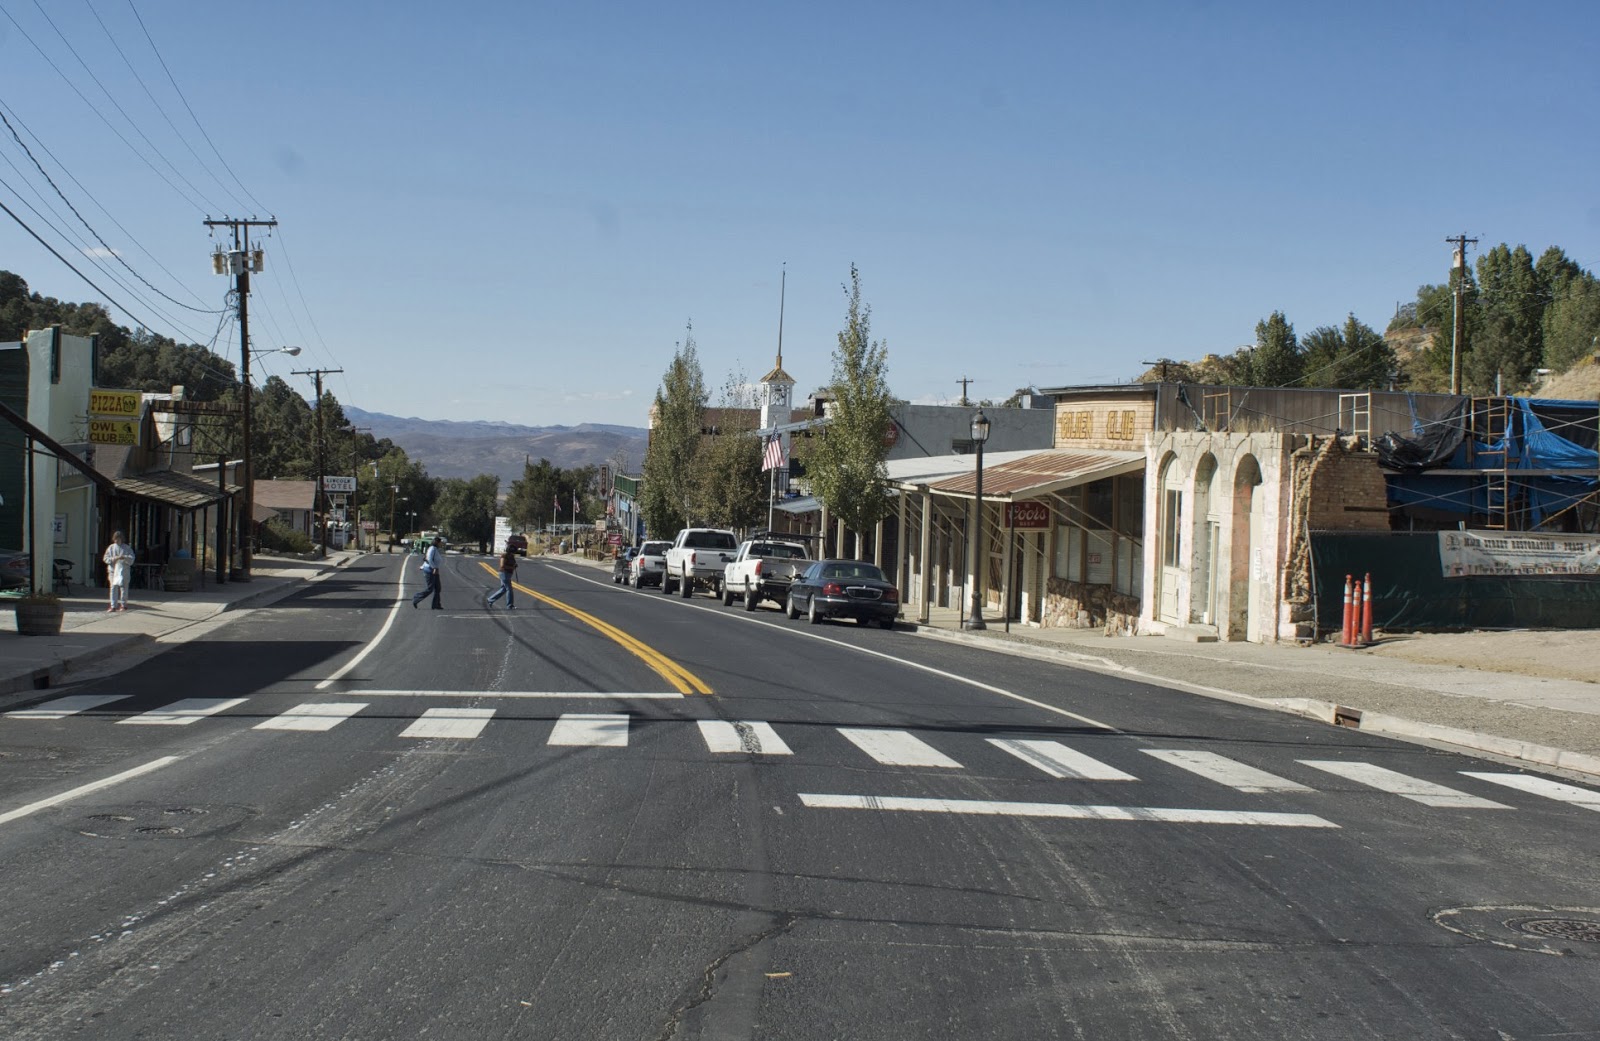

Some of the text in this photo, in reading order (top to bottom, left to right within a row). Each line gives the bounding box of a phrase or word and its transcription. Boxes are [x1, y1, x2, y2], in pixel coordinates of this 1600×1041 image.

[91, 395, 122, 412] PIZZA
[91, 422, 117, 432] OWL
[1061, 410, 1136, 441] GOLDEN CLUB
[89, 432, 117, 442] CLUB
[1484, 539, 1508, 549] STREET
[1511, 540, 1555, 550] RESTORATION
[1564, 542, 1584, 552] PHASE
